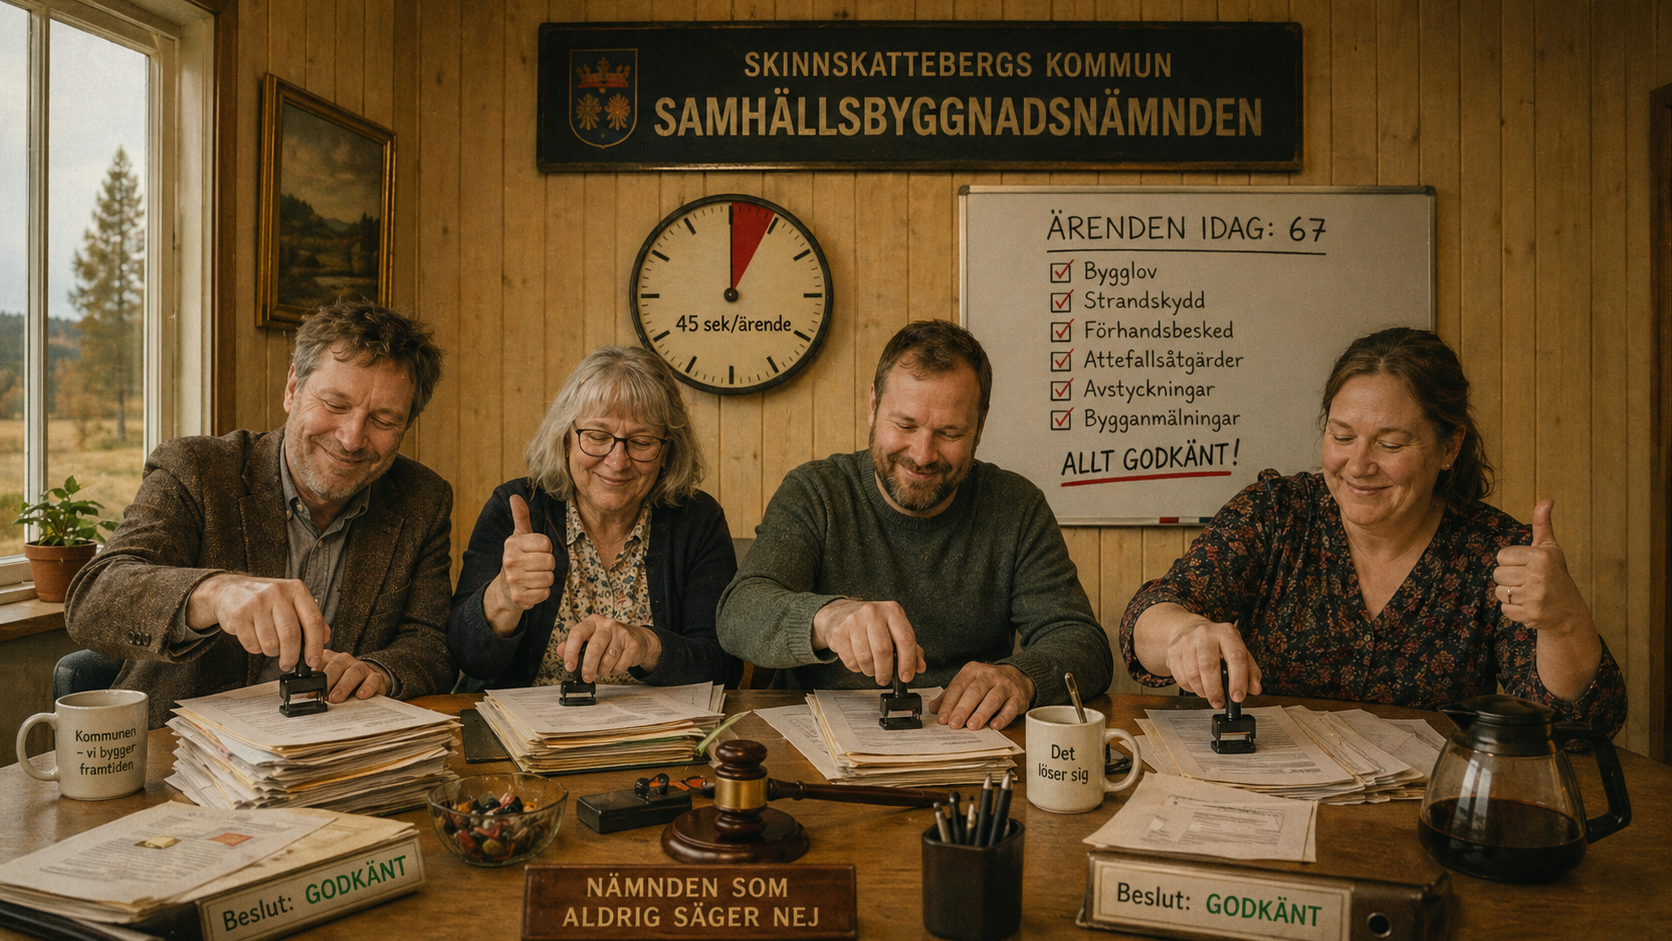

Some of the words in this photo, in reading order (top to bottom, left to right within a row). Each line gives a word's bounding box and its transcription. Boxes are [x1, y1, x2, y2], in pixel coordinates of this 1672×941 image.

[744, 51, 1033, 78] SKINNSKATTEBERGS
[1046, 51, 1173, 78] KOMMUN
[653, 87, 1263, 138] SAMHÄLLSBYGGNADSNÄMNDEN
[1046, 209, 1187, 241] ÄRENDEN
[1201, 215, 1275, 240] IDAG:
[1288, 216, 1328, 243] 67
[1083, 261, 1158, 286] Bygglov
[1083, 290, 1206, 315] Strandskydd
[675, 314, 699, 332] 45
[704, 314, 791, 333] sek/ärende
[1083, 320, 1235, 340] Förhandsbesked
[1083, 350, 1245, 375] Attefallsåtgärder
[1083, 379, 1216, 404] Avstyckningar
[1083, 408, 1242, 434] Bygganmälningar
[1060, 449, 1115, 476] ALLT
[1122, 437, 1241, 471] GODKÄNT!
[75, 727, 137, 742] Kommunen
[86, 746, 97, 758] vi
[99, 743, 136, 760] bygger
[1050, 743, 1076, 762] Det
[79, 760, 134, 776] framtiden
[1037, 762, 1068, 782] löser
[1070, 765, 1090, 785] sig
[221, 894, 295, 932] Beslut:
[304, 854, 408, 905] GODKÄNT
[586, 872, 719, 898] NÄMNDEN
[731, 877, 789, 898] SOM
[561, 905, 662, 928] ALDRIG
[673, 900, 760, 928] SÄGER
[772, 906, 820, 929] NEJ
[1116, 881, 1192, 911] Beslut:
[1204, 892, 1323, 928] GODKÄNT
